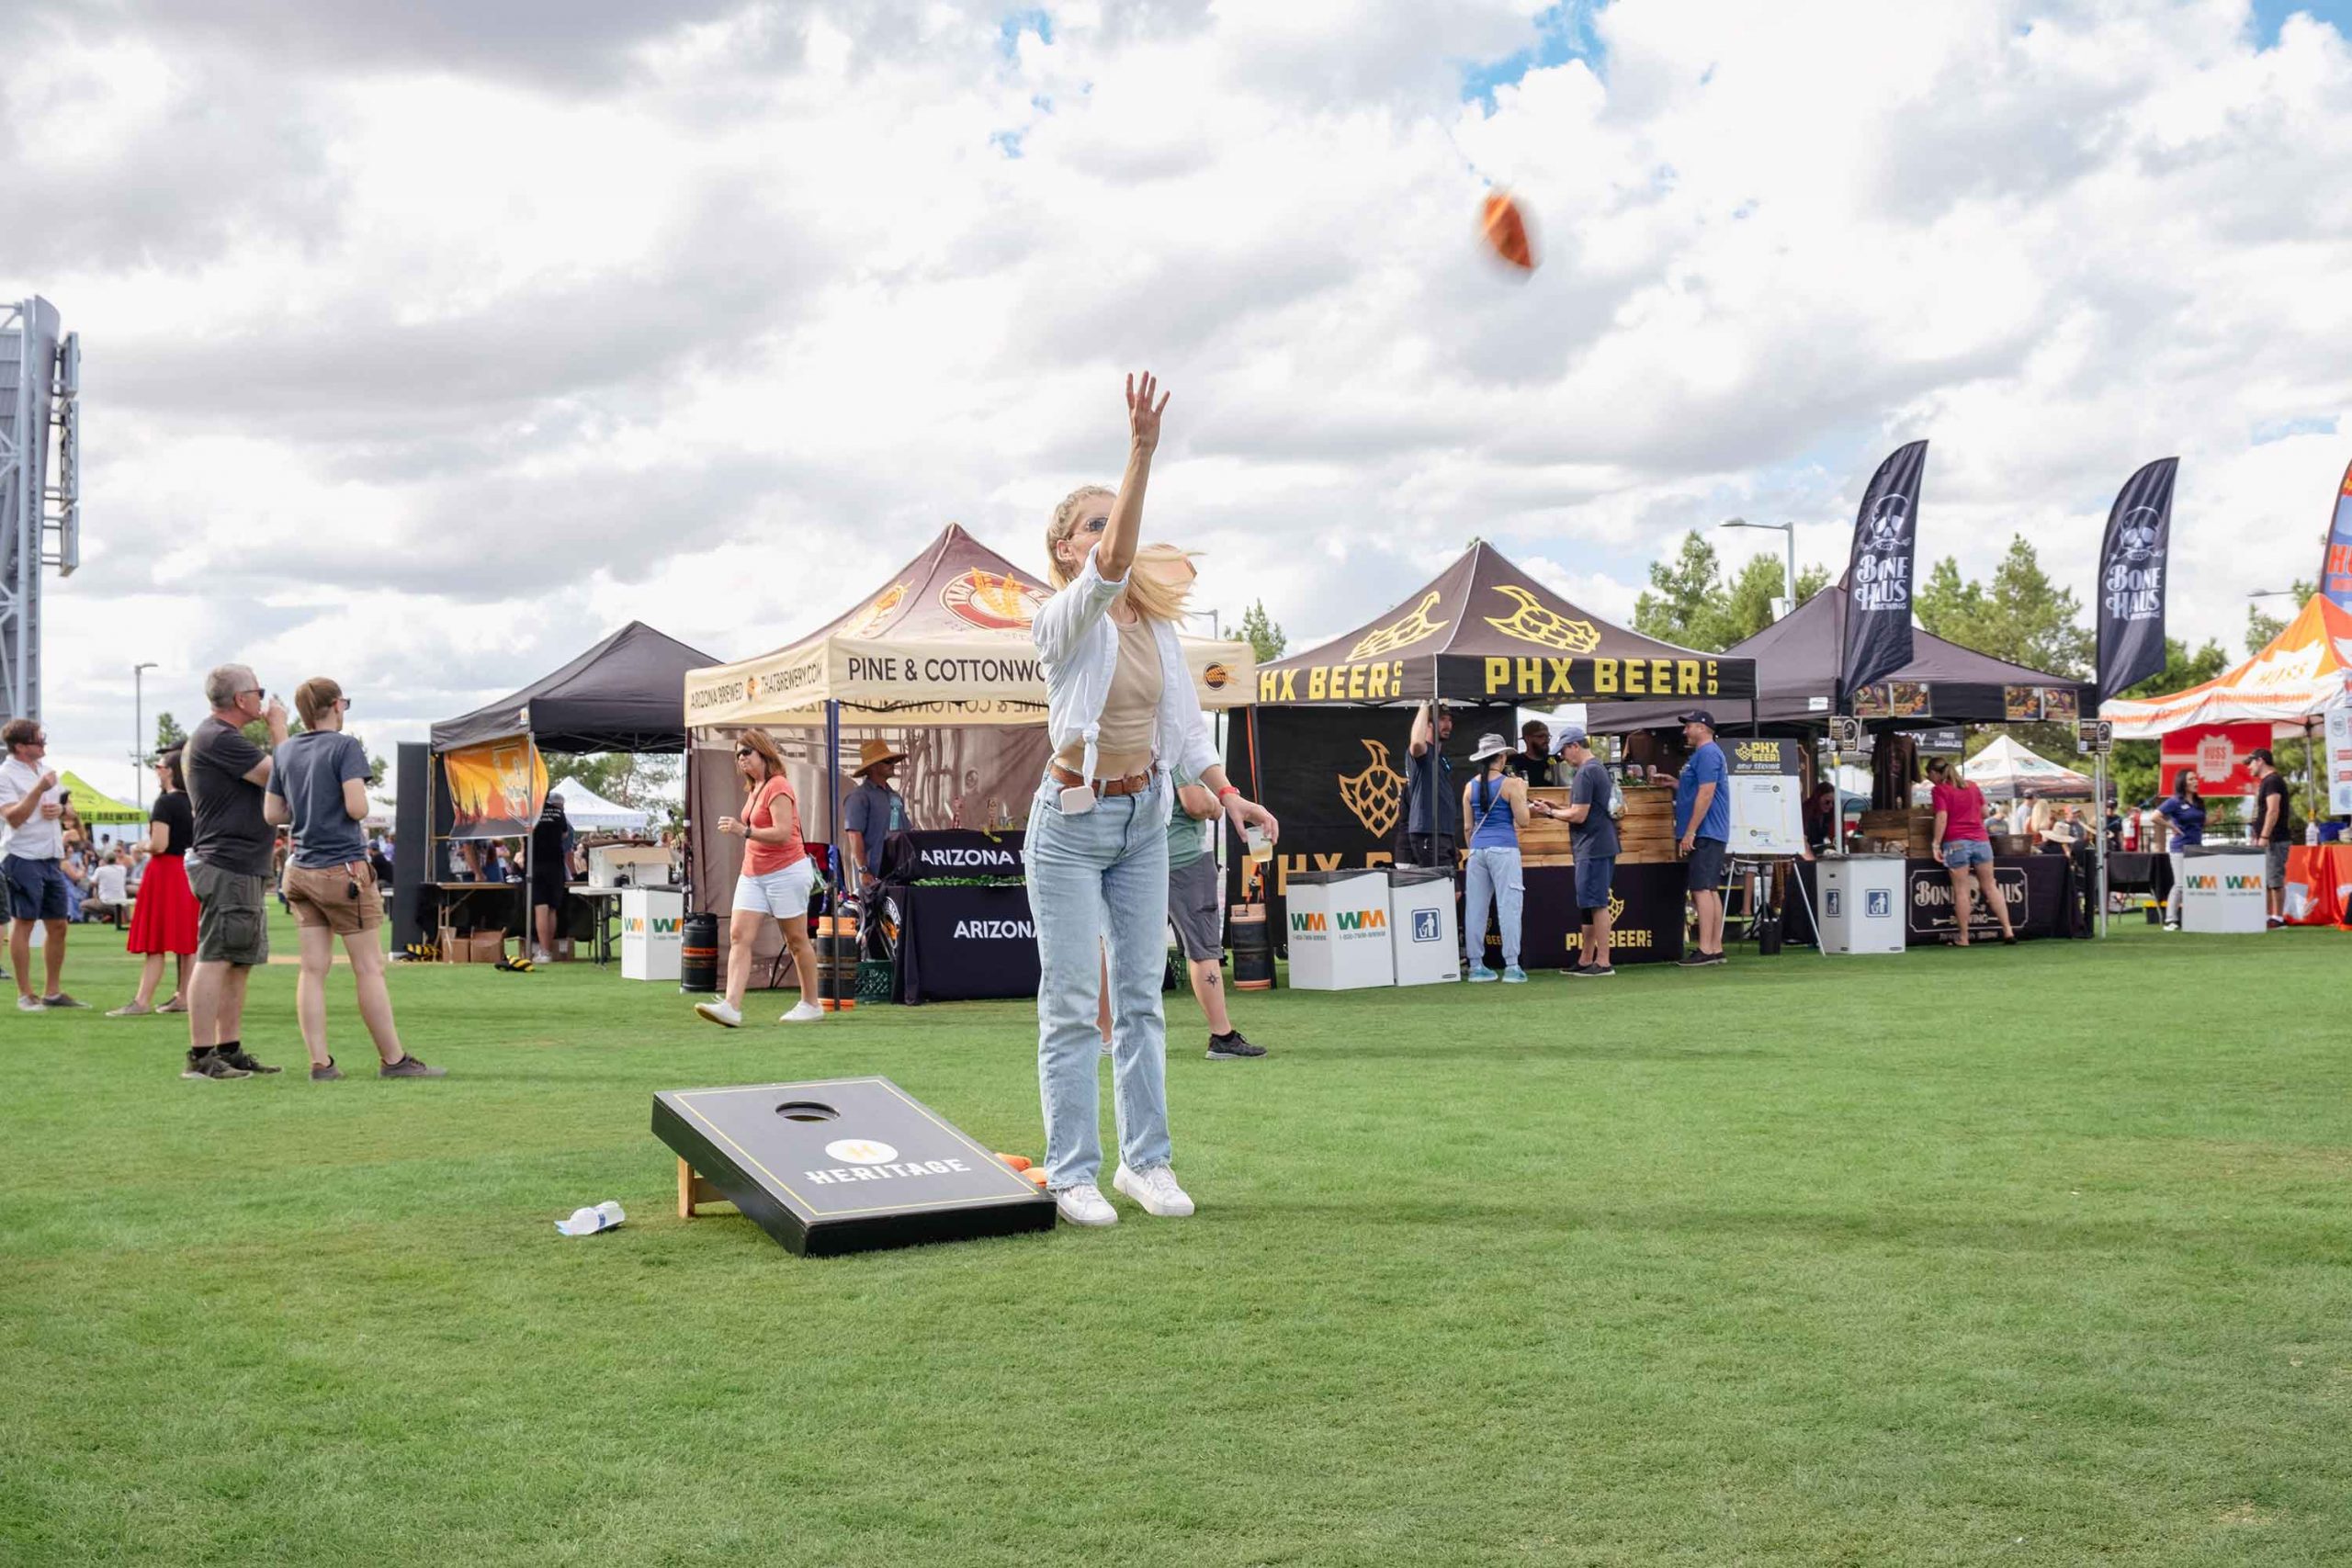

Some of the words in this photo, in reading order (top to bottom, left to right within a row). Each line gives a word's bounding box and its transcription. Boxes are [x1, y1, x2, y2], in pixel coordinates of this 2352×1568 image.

[2106, 564, 2161, 592] BONE
[2106, 589, 2160, 621] HAUS
[849, 658, 897, 682] PINE
[905, 659, 917, 682] &
[1485, 657, 1575, 694] PHX
[1594, 658, 1700, 695] BEER
[690, 687, 718, 710] ARIZONA
[718, 682, 743, 705] BREWED
[761, 660, 823, 695] THATBREWERY.COM
[1256, 668, 1301, 703] HX
[1308, 662, 1389, 701] BEER
[1751, 742, 1780, 753] PHX
[1752, 753, 1776, 761] BEER
[921, 850, 1015, 865] ARIZONA
[2187, 875, 2217, 889] WM
[2225, 875, 2262, 889] WM
[624, 917, 644, 931] WM
[954, 920, 1037, 939] ARIZON
[1291, 912, 1328, 931] WM
[1336, 909, 1386, 931] WM
[1486, 934, 1502, 945] BEE
[1609, 930, 1646, 948] BEER
[804, 1158, 972, 1185] HERITAGE
